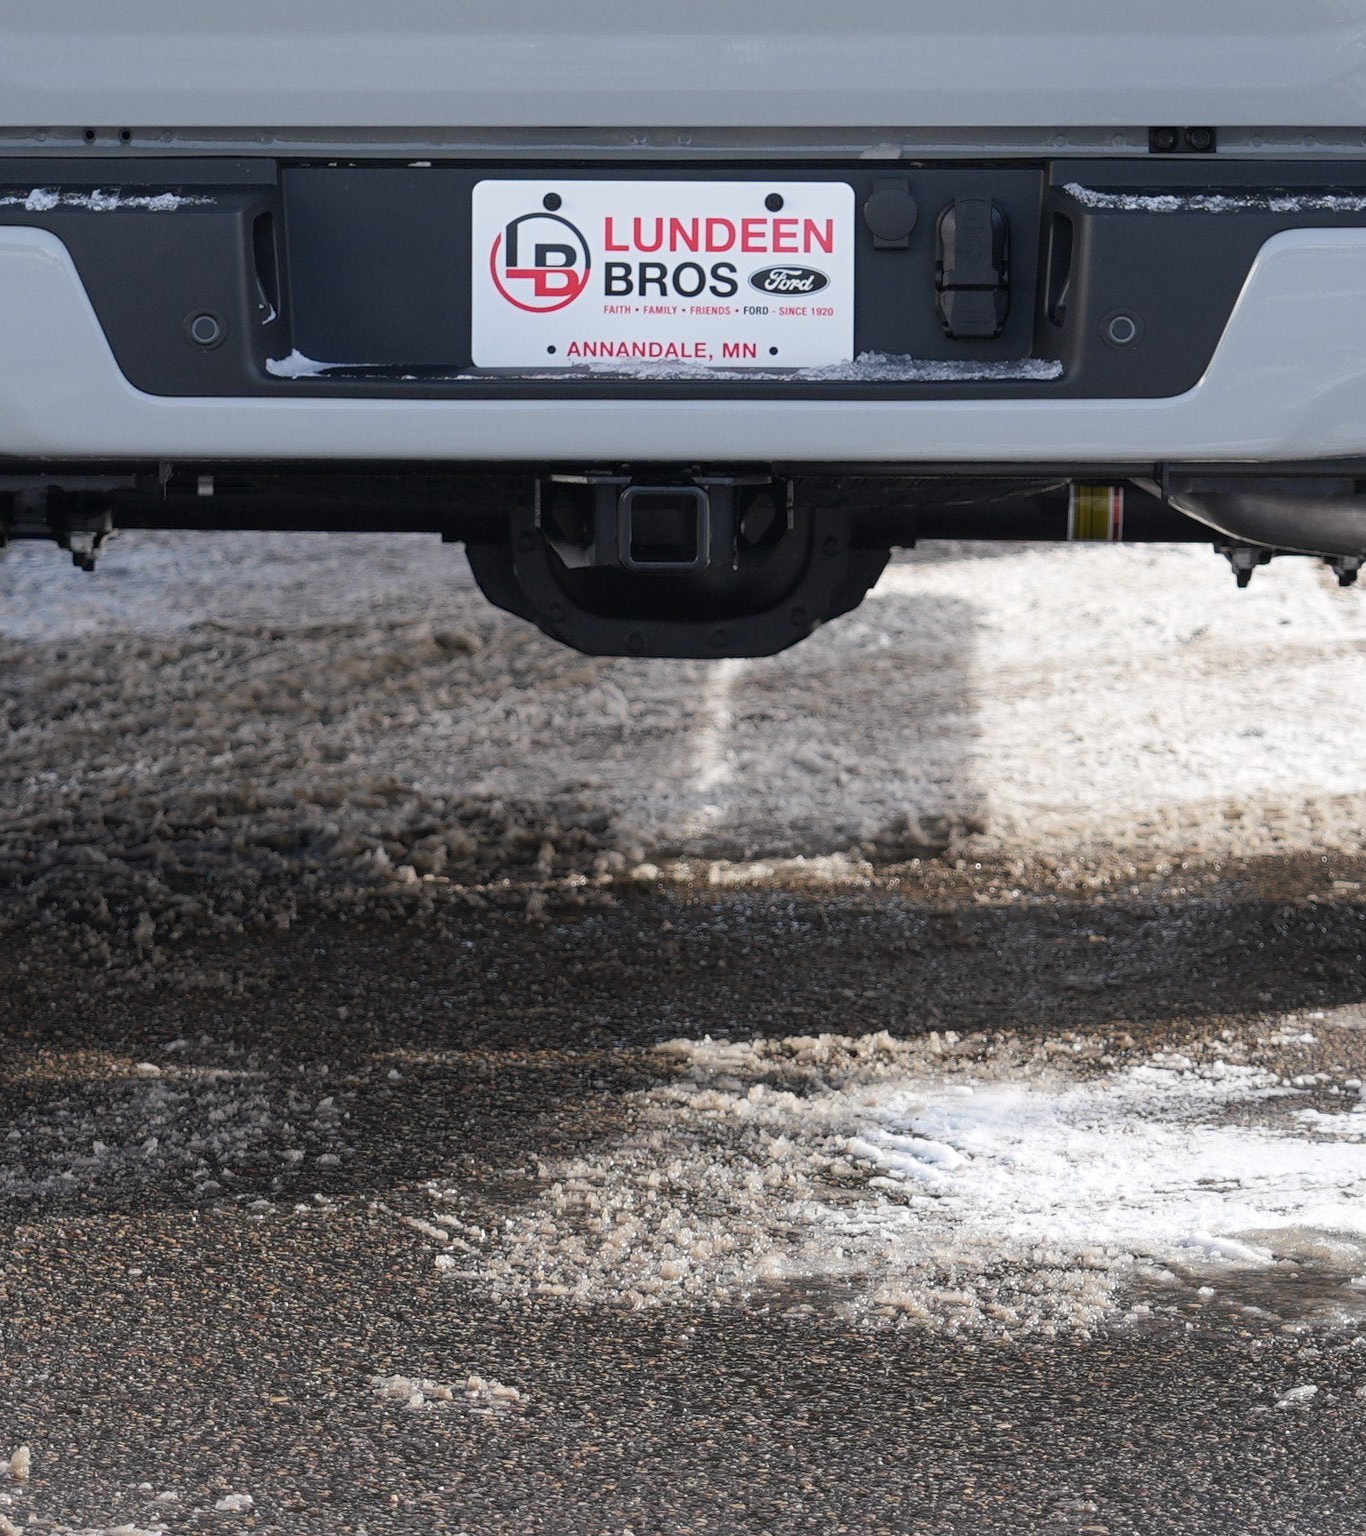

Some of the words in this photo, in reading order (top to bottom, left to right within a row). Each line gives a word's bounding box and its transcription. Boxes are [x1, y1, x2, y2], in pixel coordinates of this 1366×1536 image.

[604, 216, 834, 254] LUNDEEN
[603, 262, 738, 297] BROS
[763, 268, 814, 292] Ford
[603, 305, 631, 314] FAITH
[643, 305, 677, 315] FAMILY
[690, 306, 731, 315] FRIENDS
[743, 306, 769, 315] FORD
[779, 307, 807, 316] SINCE
[811, 307, 834, 316] 1920
[567, 342, 714, 360] ANNANDALE,
[722, 344, 757, 358] MN
